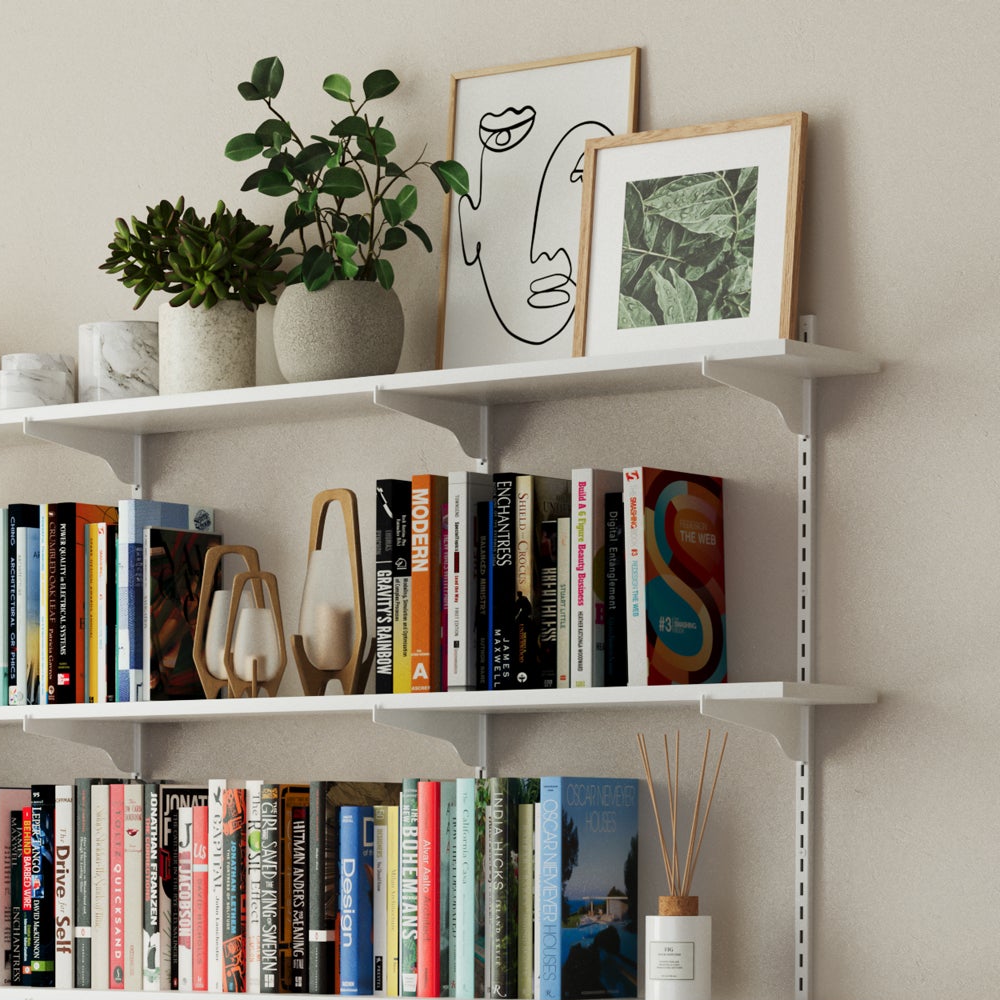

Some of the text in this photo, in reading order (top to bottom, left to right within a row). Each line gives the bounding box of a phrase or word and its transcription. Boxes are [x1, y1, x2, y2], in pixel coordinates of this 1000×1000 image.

[578, 481, 586, 502] Build
[412, 488, 428, 572] MODERN
[496, 481, 512, 566] ENCHANTRESS
[518, 492, 528, 584] SHIELD CROCUS
[576, 518, 586, 542] Figure
[608, 512, 618, 542] Digital
[680, 530, 717, 546] THE WEB
[576, 544, 586, 571] Beauty
[578, 572, 586, 606] Business
[608, 547, 618, 610] Entanglement
[376, 570, 392, 674] GRAVITY'S RAINBOW
[658, 616, 672, 632] #3
[412, 662, 428, 680] A
[252, 795, 260, 816] The
[376, 809, 384, 820] 50
[566, 785, 636, 808] OSCAR NIEMEYER
[262, 802, 277, 830] GIRL
[585, 811, 616, 832] HOUSES
[23, 820, 31, 854] BEHIND
[32, 807, 41, 874] LEPER TANGO
[180, 823, 192, 848] J
[194, 843, 206, 859] Us
[213, 814, 222, 892] CAPITAL
[292, 820, 305, 864] HITMAN
[494, 793, 503, 890] INDIA HICKS
[23, 856, 31, 888] BARBED
[56, 845, 70, 898] Drive
[262, 841, 277, 880] SAVED
[23, 888, 31, 908] WIRE
[226, 892, 230, 901] OF
[292, 867, 305, 908] ANDERS
[402, 826, 418, 940] BOHEMIANS
[423, 840, 431, 941] Alvar Aalto Architect
[543, 799, 558, 980] OSCAR NIEMEYER HOUSES
[58, 902, 67, 913] for
[250, 880, 260, 924] Effect
[262, 890, 277, 918] KING
[342, 858, 355, 948] Design
[12, 906, 20, 982] ENCHANTRESS
[56, 916, 71, 954] Self
[262, 924, 277, 971] SWEDEN
[293, 910, 304, 957] MEANING
